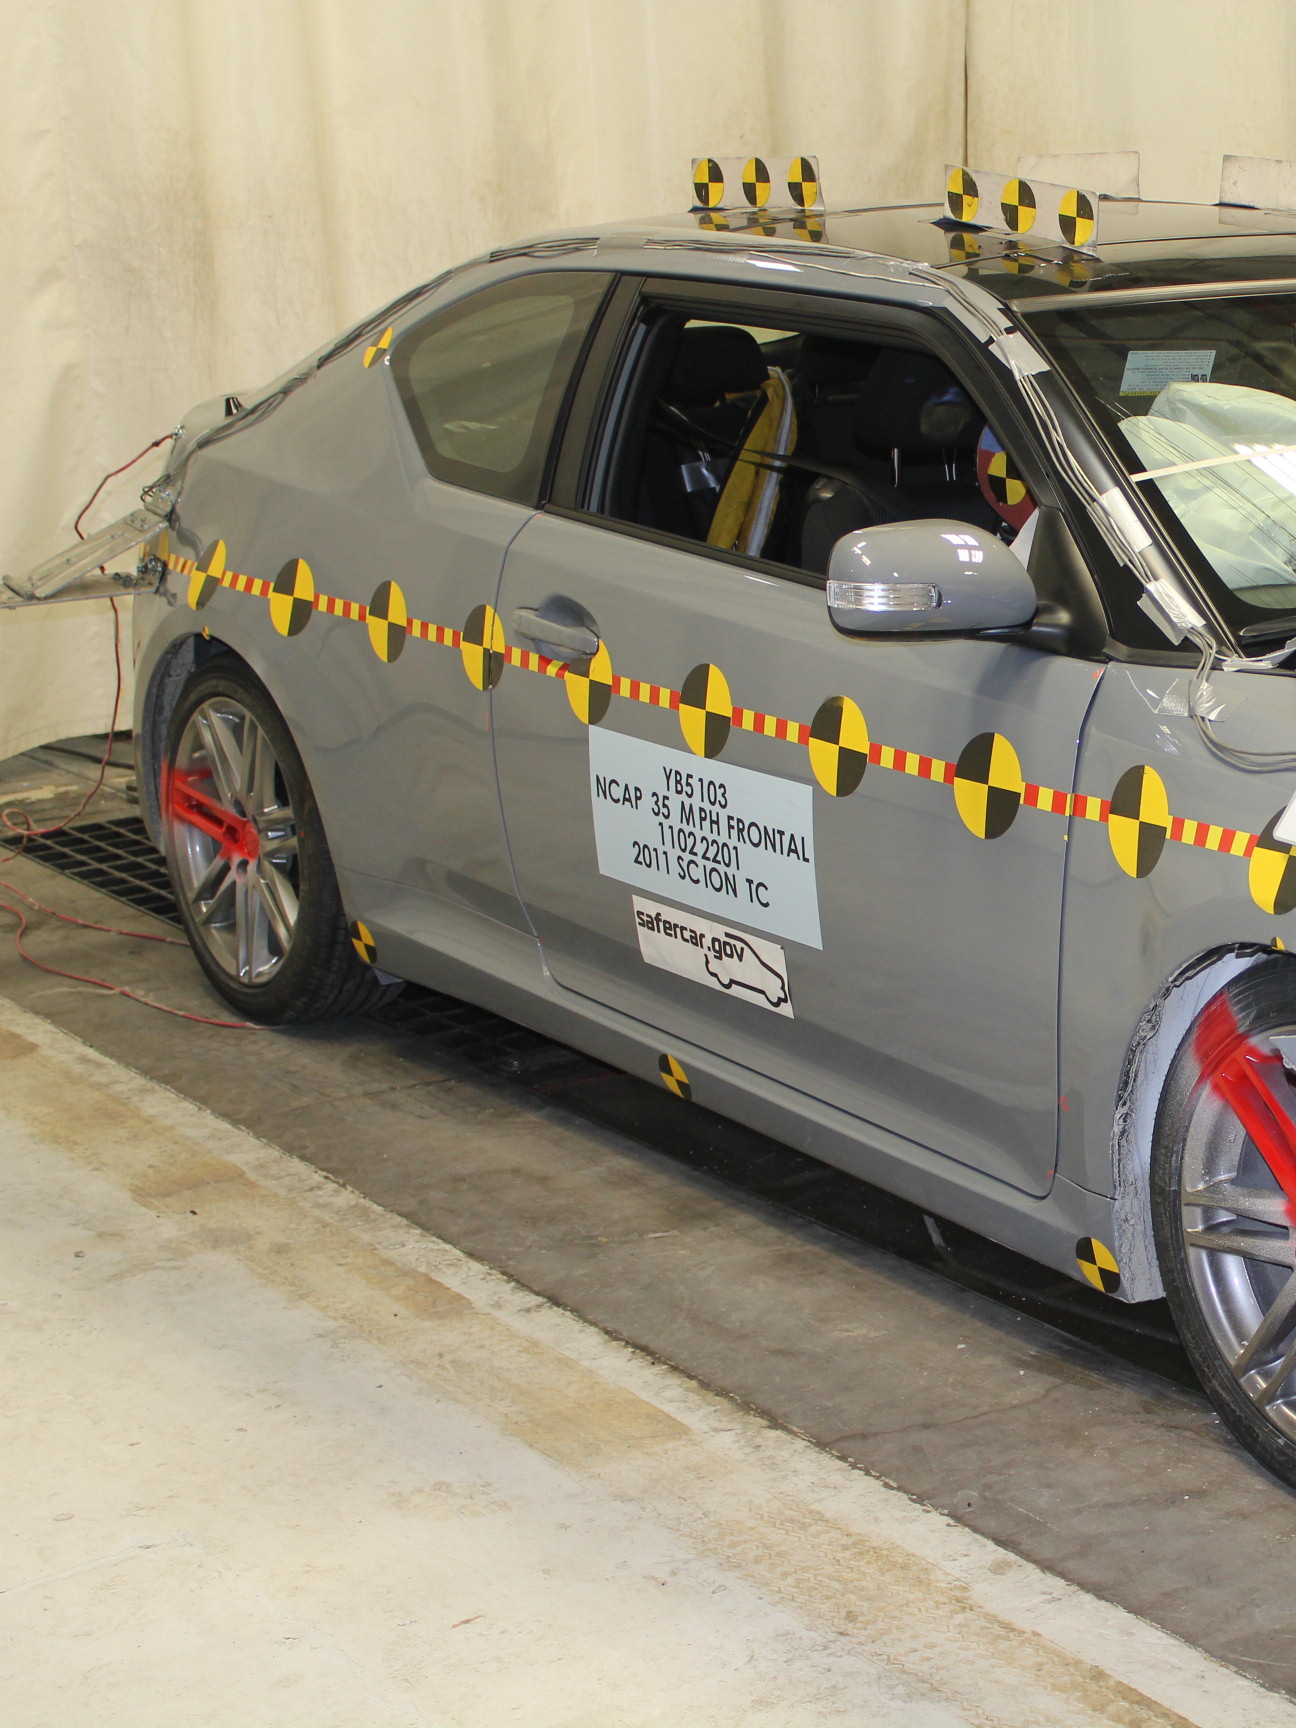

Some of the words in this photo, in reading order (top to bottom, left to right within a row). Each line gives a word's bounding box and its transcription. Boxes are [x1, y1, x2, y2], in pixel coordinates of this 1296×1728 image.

[663, 766, 728, 809] YB5103
[595, 774, 643, 810] NCAP
[651, 791, 670, 819] 35
[680, 801, 721, 836] MPH
[727, 815, 810, 863] FRONTAL
[658, 822, 740, 871] 11022201
[632, 841, 670, 875] 2011
[677, 855, 738, 898] SCION
[746, 878, 770, 908] TC
[636, 909, 744, 963] safercar.gov
